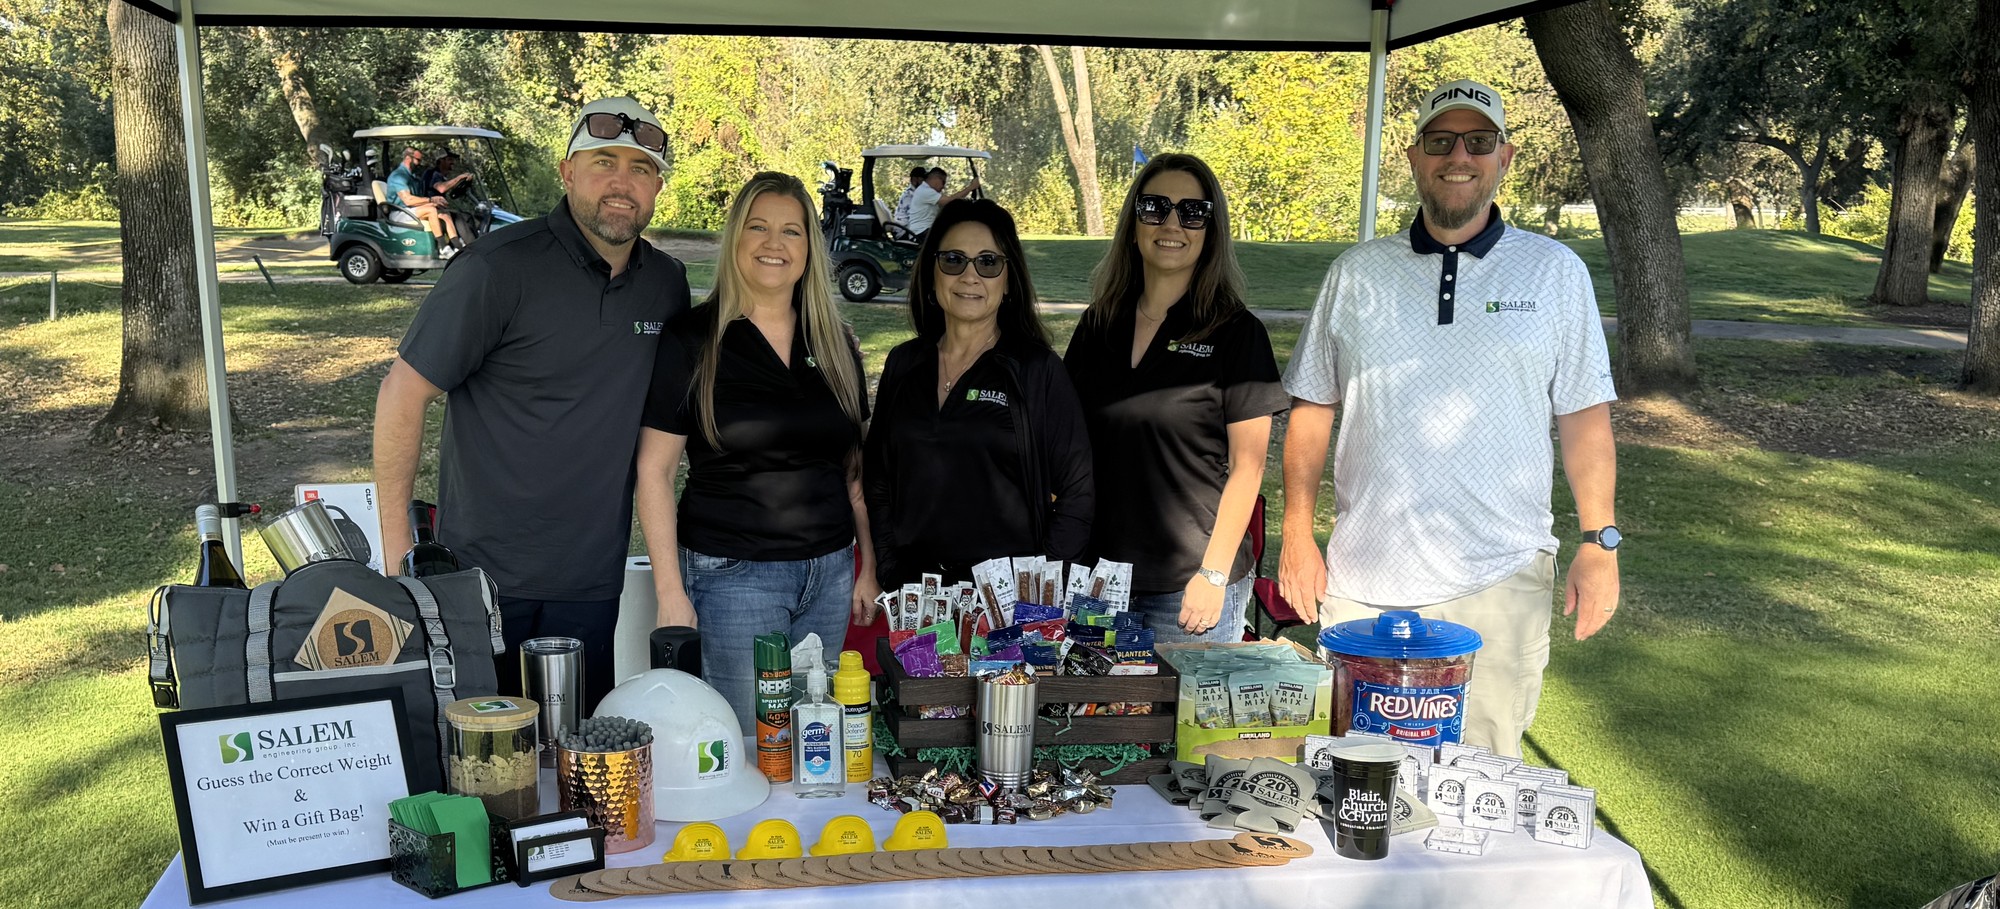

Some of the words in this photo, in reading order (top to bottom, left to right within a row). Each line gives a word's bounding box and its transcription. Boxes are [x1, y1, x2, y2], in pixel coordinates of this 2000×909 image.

[1431, 87, 1491, 110] PING
[1500, 301, 1536, 309] SALEM
[643, 321, 664, 330] SALE
[1180, 343, 1214, 353] SALEM
[334, 651, 381, 667] SALEM
[1117, 650, 1151, 659] PLANTERS
[758, 677, 792, 695] REPE
[1196, 687, 1229, 695] TRAIL
[1202, 694, 1223, 702] MIX
[1237, 691, 1269, 700] TRAIL
[1275, 689, 1309, 700] TRAIL
[1244, 698, 1266, 707] MIX
[1279, 697, 1301, 706] MIX
[768, 712, 789, 721] 40%
[994, 723, 1031, 734] SALEM
[1395, 729, 1420, 738] ORIGINAL
[257, 719, 356, 750] SALEM
[263, 747, 312, 760] engineering
[852, 750, 862, 758] 70
[197, 773, 245, 791] Guess
[249, 770, 273, 785] the
[277, 762, 334, 780] Correct
[337, 753, 392, 771] Weight
[1231, 778, 1241, 788] 2
[1258, 773, 1297, 791] ANNIVERSARY
[1265, 778, 1286, 791] 20
[1446, 785, 1458, 793] 20
[294, 788, 308, 803] &
[1256, 787, 1300, 807] SALEM
[1348, 788, 1381, 803] Blair,
[1522, 794, 1534, 803] 20
[1342, 798, 1388, 812] Church
[1484, 798, 1496, 806] 20
[1519, 803, 1536, 811] SALE
[243, 818, 277, 834] Win
[281, 818, 290, 829] a
[294, 810, 325, 827] Gift
[329, 804, 365, 823] Bag!
[1557, 812, 1569, 821] 20
[266, 837, 287, 848] (Must
[288, 835, 297, 844] be
[298, 832, 323, 844] present
[323, 831, 331, 839] to
[331, 828, 350, 838] win.)
